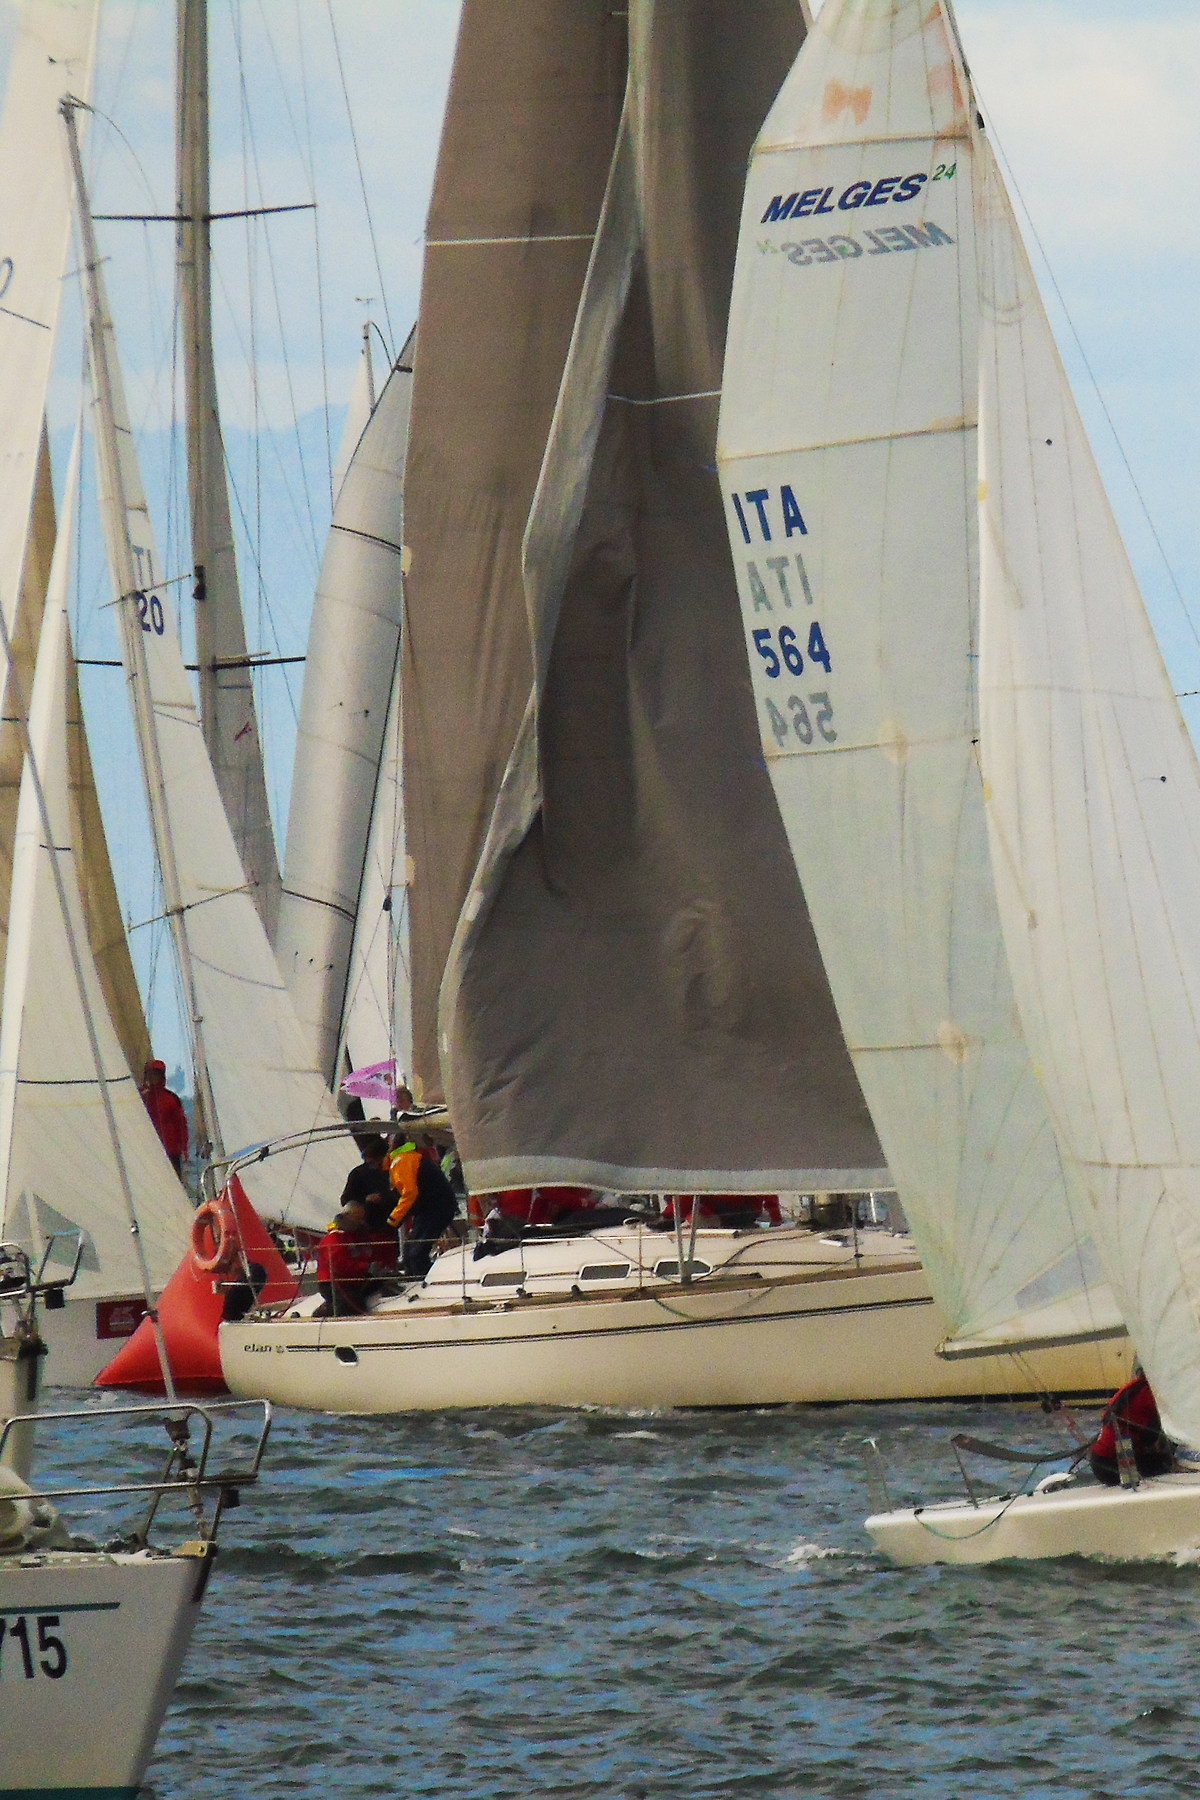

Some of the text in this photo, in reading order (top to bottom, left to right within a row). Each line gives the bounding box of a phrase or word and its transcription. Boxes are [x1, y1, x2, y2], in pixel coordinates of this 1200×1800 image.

[760, 162, 957, 224] MELGES 24
[732, 485, 808, 544] ITA
[752, 621, 832, 679] 564
